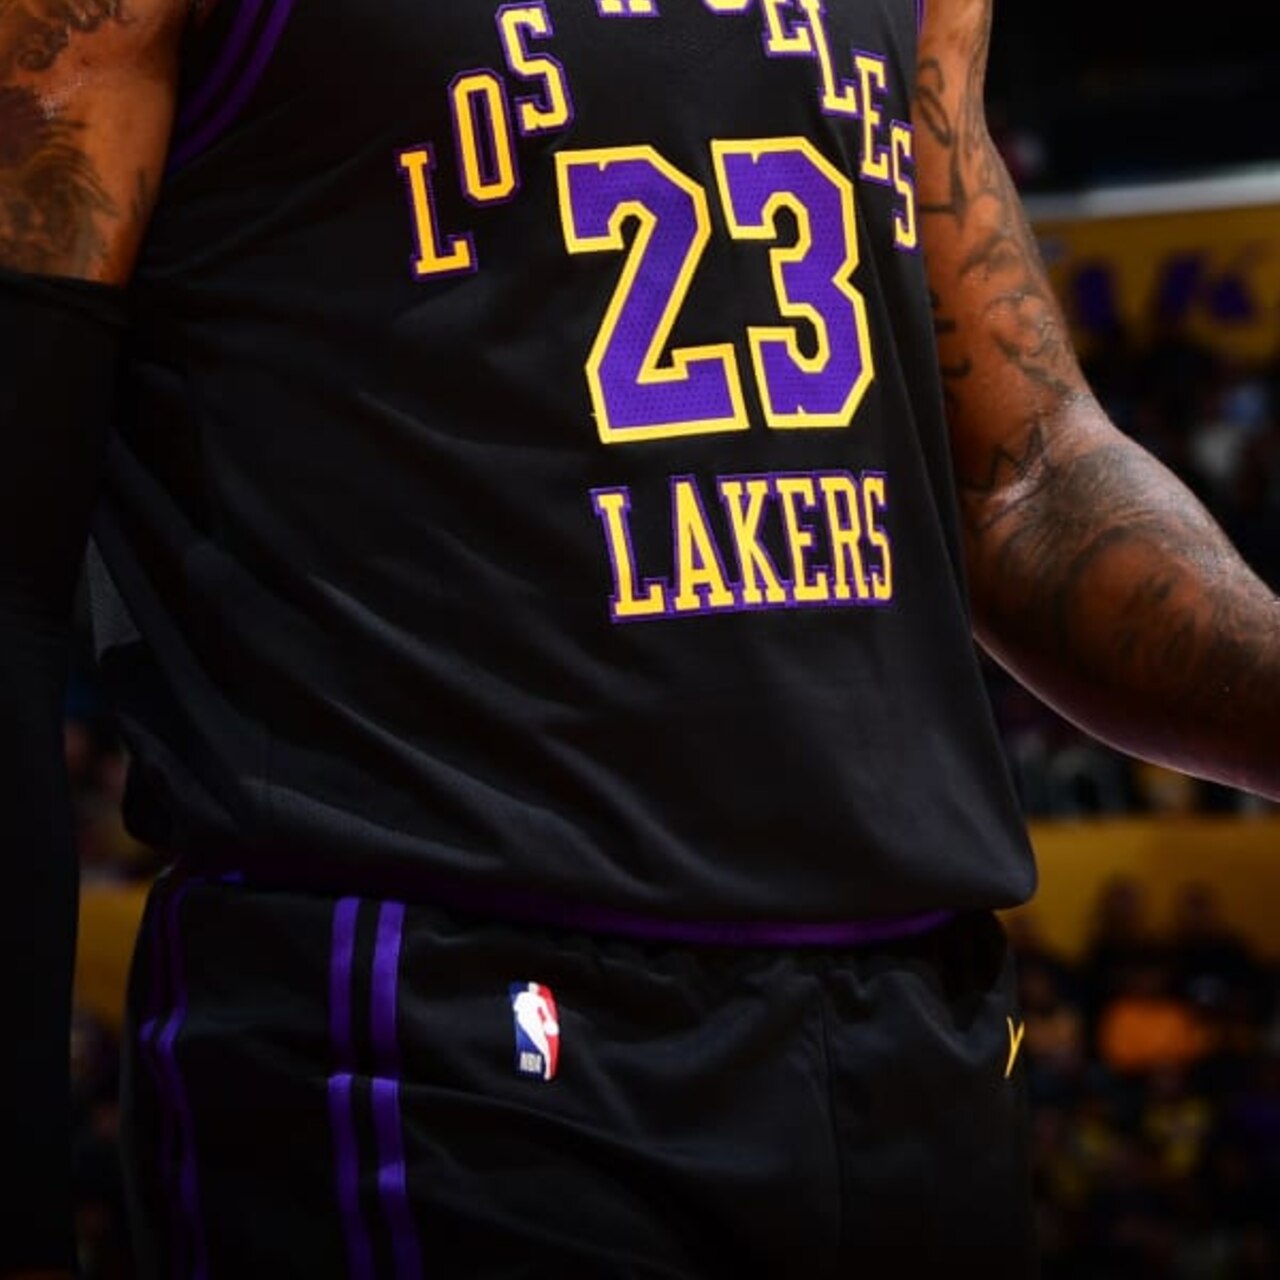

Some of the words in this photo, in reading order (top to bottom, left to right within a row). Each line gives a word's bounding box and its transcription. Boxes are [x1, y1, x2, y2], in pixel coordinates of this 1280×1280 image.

[396, 0, 575, 279] LOS
[554, 136, 875, 444] 23
[589, 469, 895, 624] LAKERS
